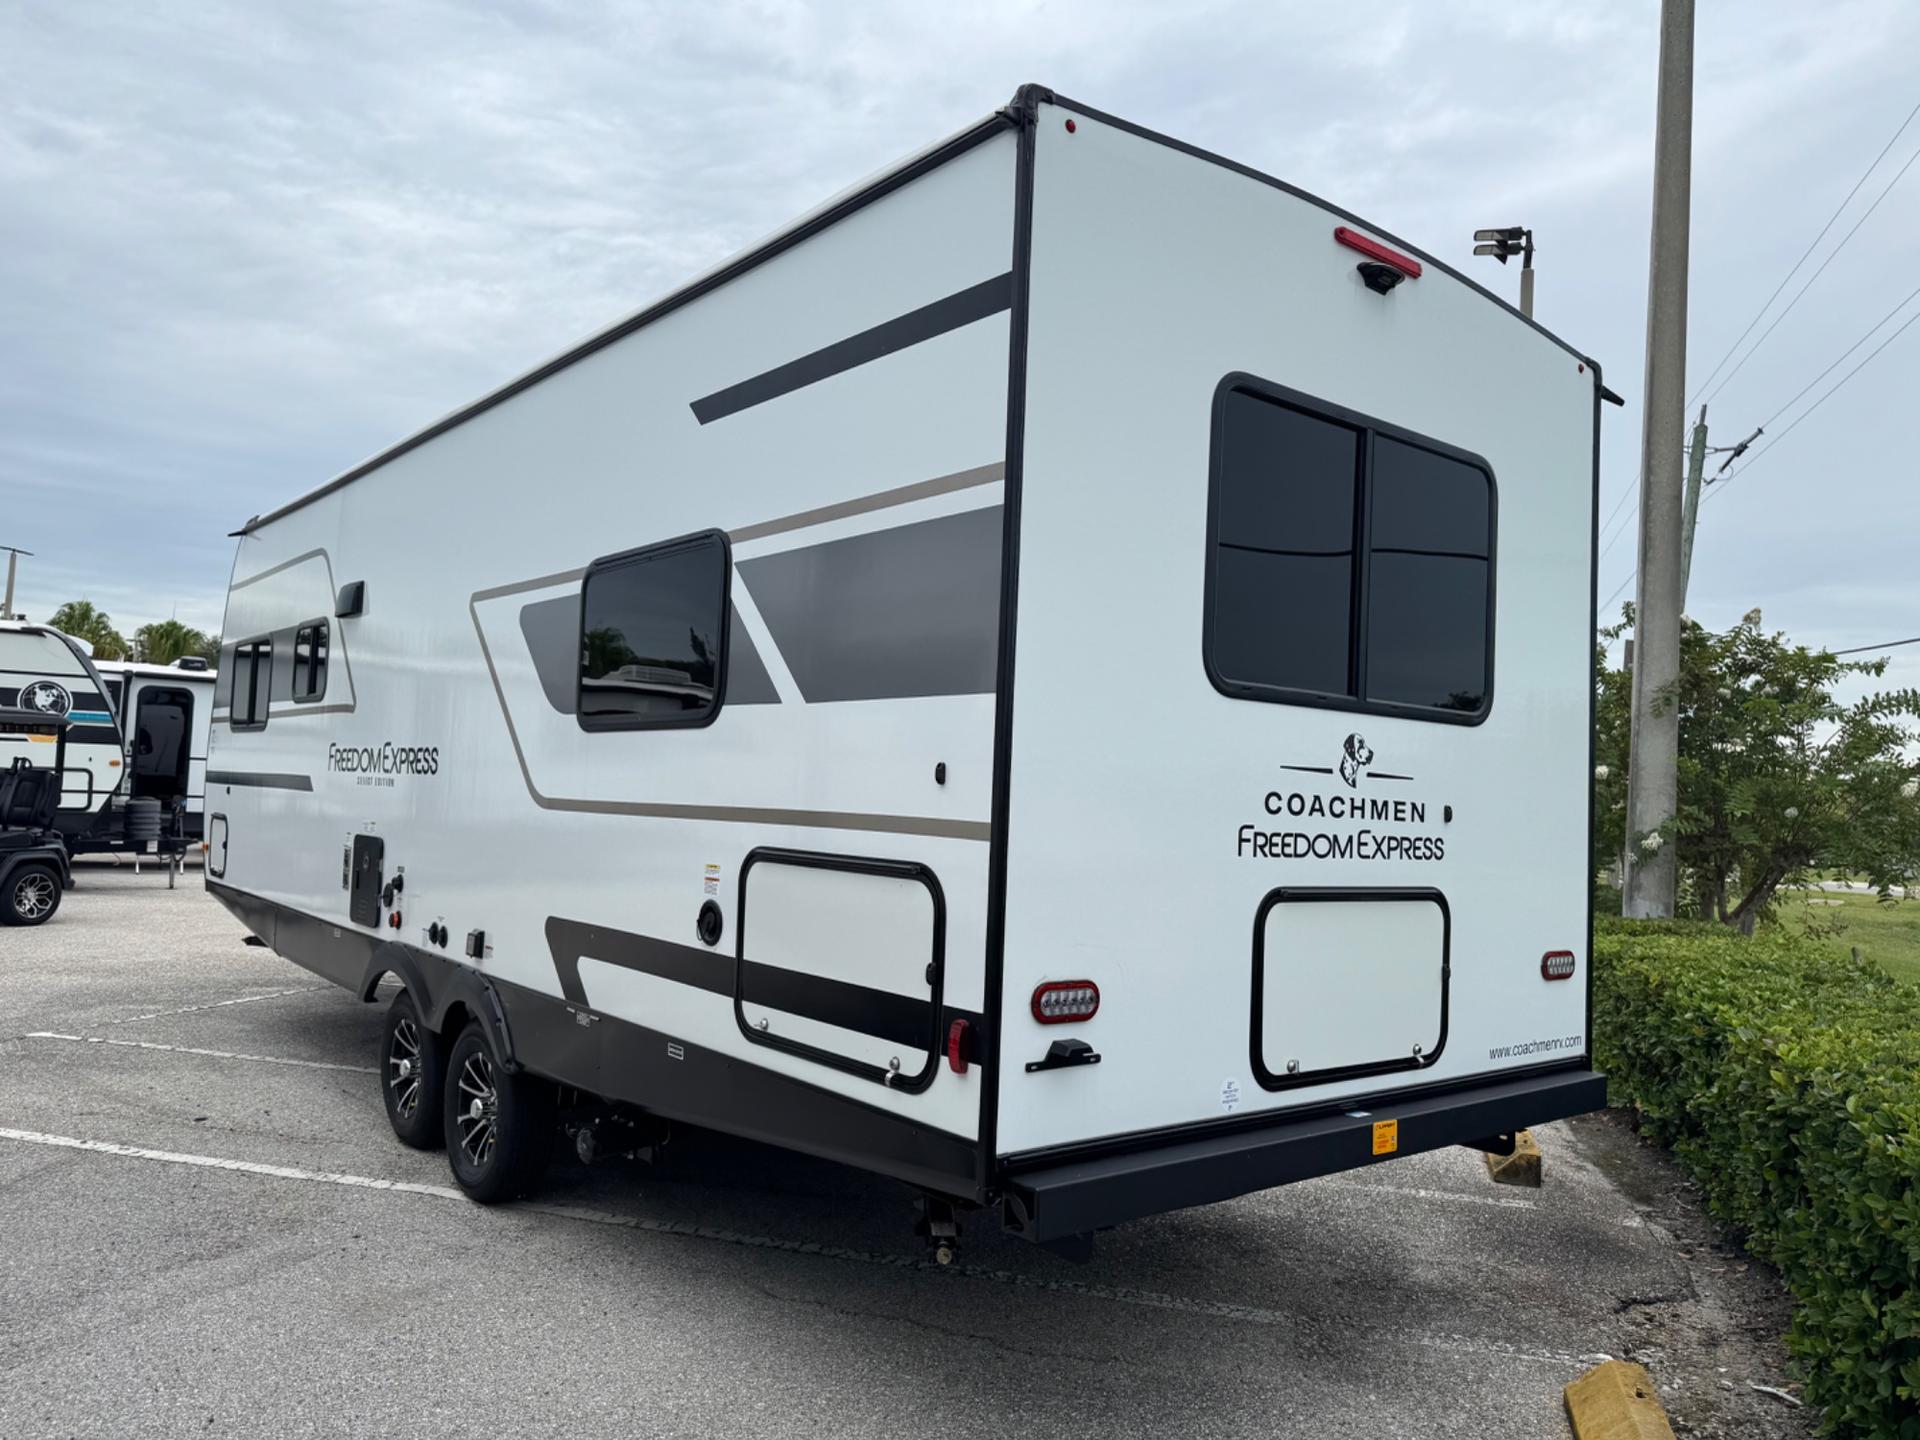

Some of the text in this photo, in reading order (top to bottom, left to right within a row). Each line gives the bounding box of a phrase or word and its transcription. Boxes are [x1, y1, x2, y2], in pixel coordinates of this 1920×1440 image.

[1264, 791, 1426, 823] COACHMEN
[1237, 824, 1445, 861] FREEDOM EXPRESS
[1489, 1035, 1582, 1060] www.coachmenrv.com
